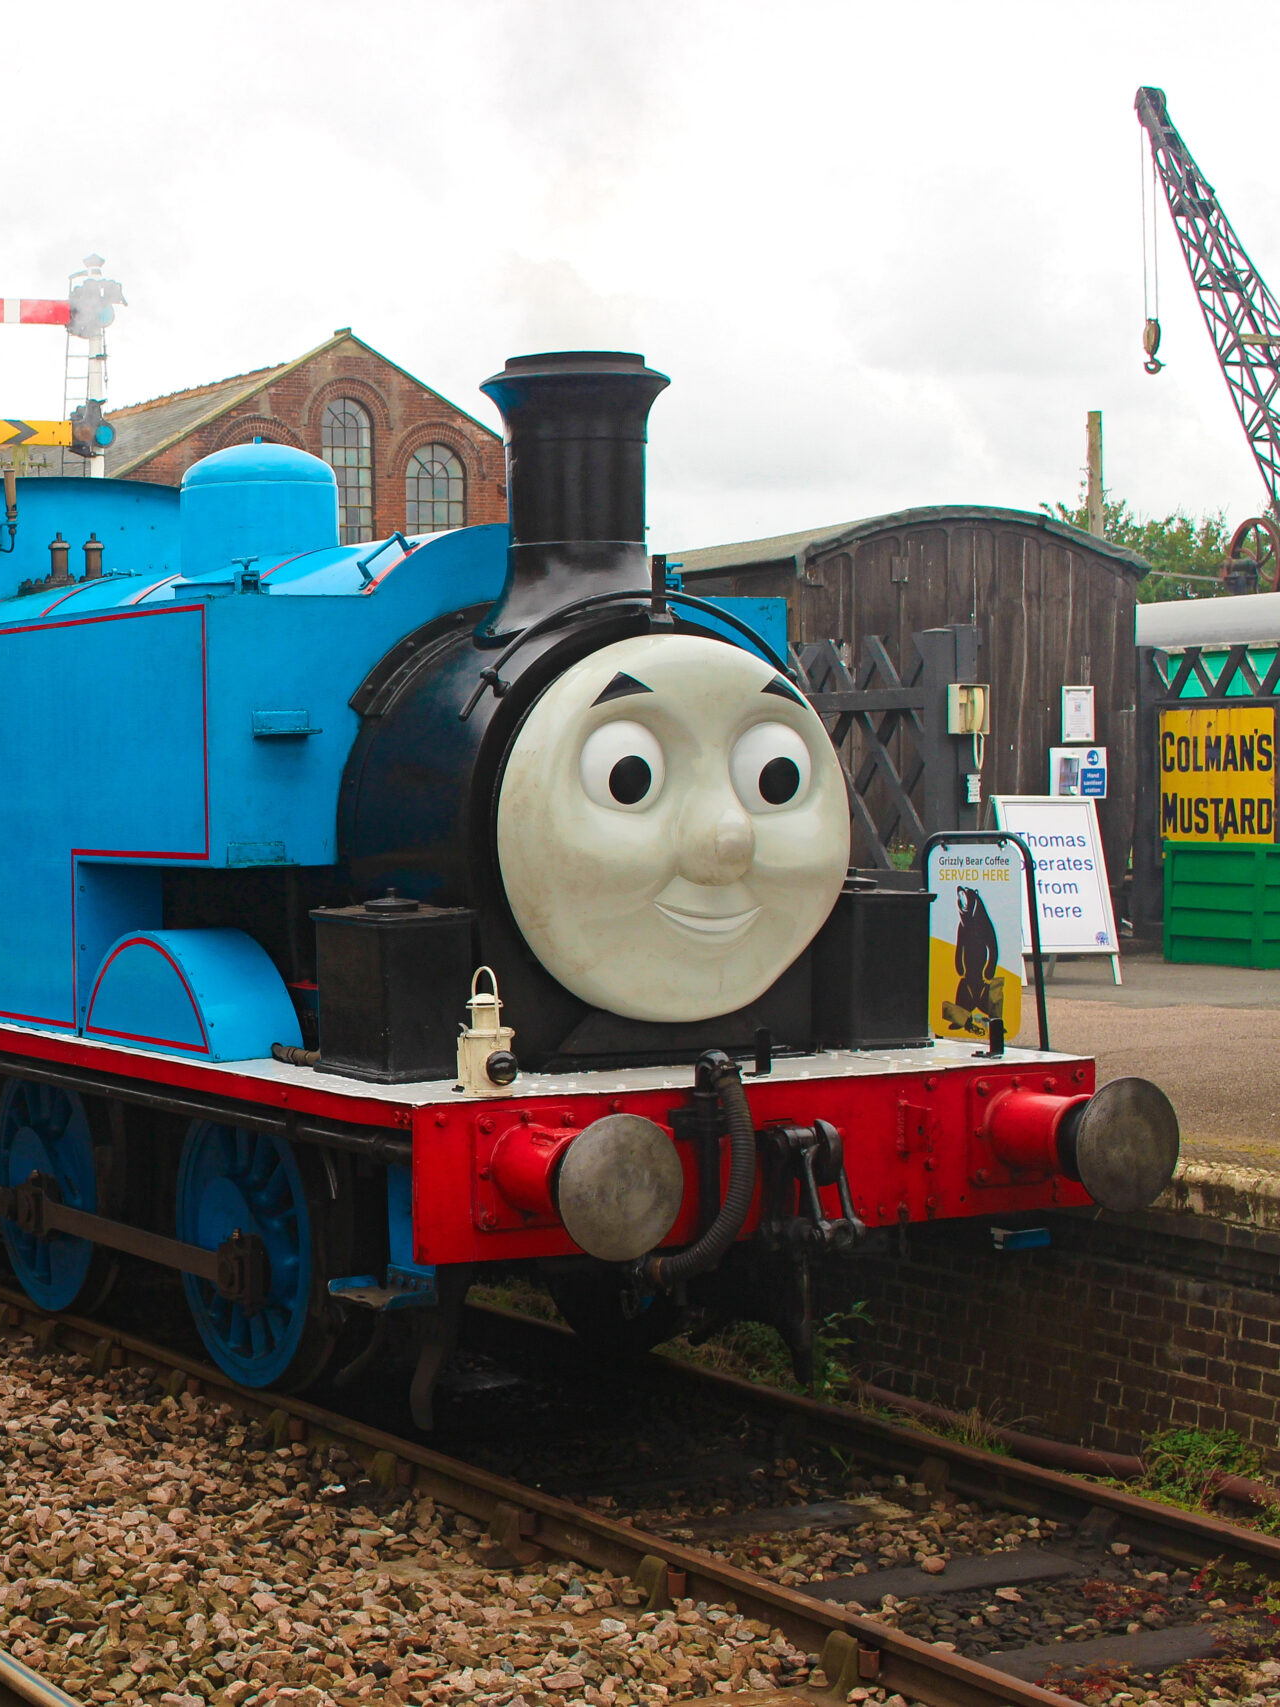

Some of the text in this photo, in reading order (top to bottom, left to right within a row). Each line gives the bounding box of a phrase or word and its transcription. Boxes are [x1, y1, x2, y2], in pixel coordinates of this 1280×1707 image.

[1162, 728, 1273, 773] COLMAN'S
[1162, 792, 1273, 835] MUSTARD
[938, 855, 1010, 867] Grizzly Bear Coffee
[938, 869, 1010, 881] SERVED HERE
[1037, 879, 1079, 895] from
[1042, 903, 1082, 918] here
